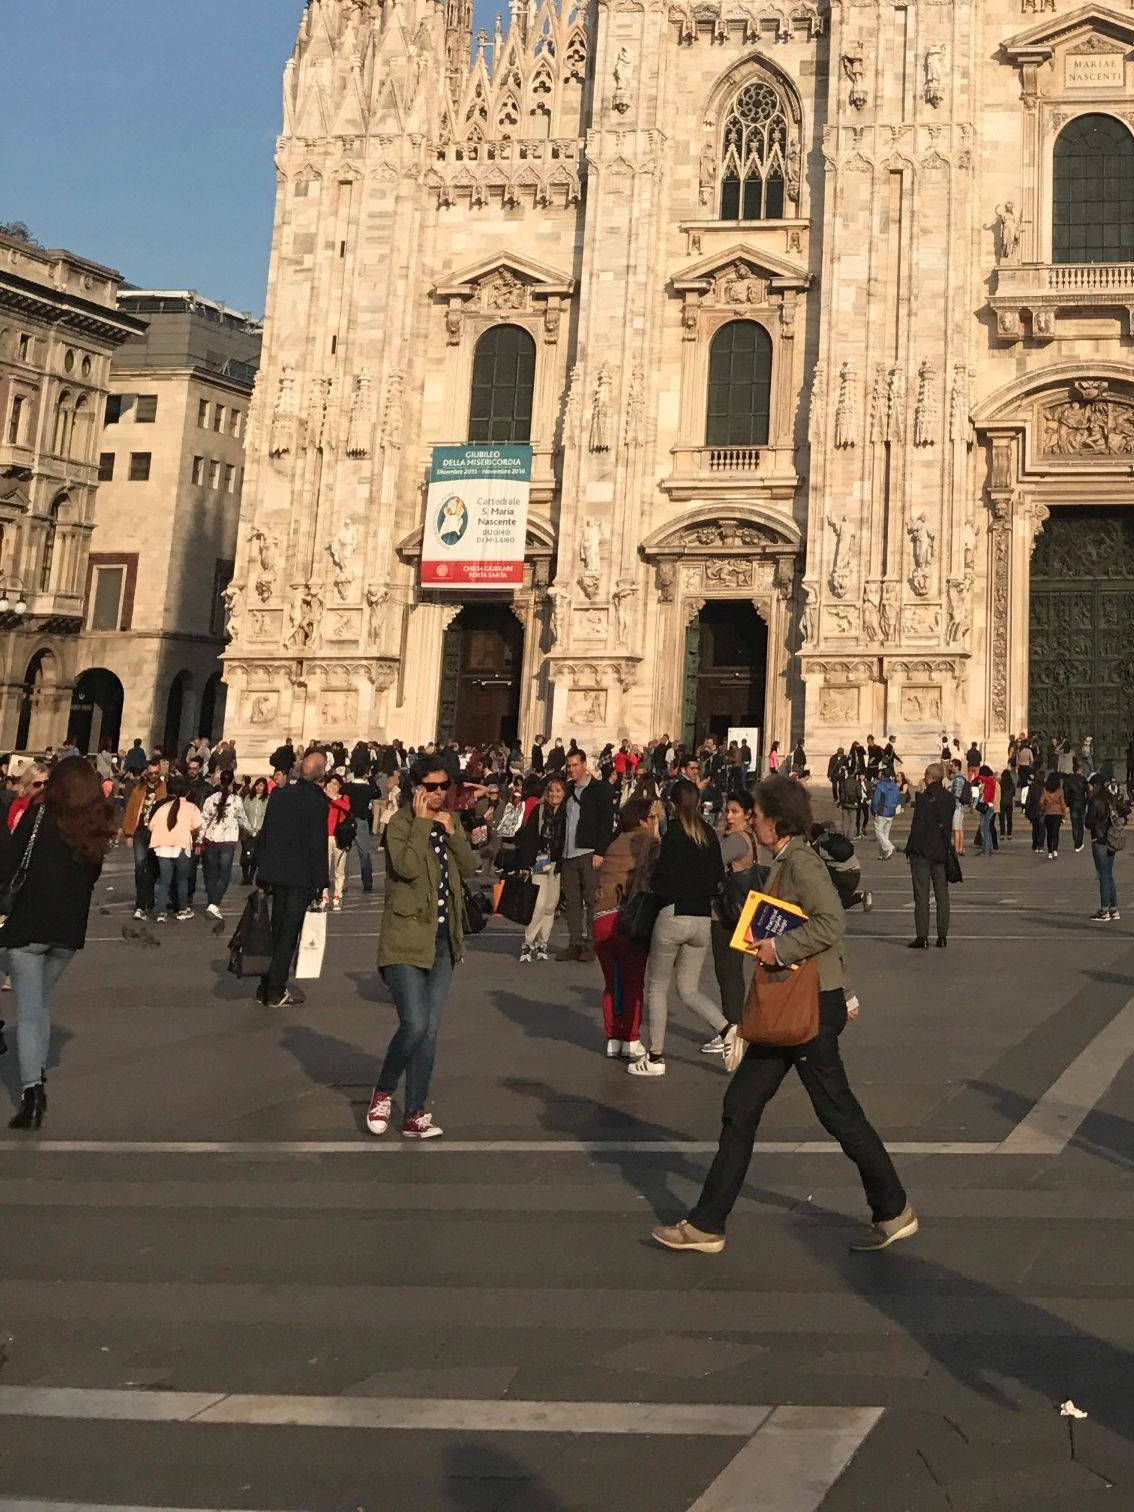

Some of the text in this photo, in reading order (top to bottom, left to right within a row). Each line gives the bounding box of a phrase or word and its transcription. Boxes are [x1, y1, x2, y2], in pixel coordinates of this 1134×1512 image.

[1074, 59, 1115, 68] MARIAE
[1069, 72, 1121, 80] NASCENTI
[467, 458, 521, 466] MISERICORDIA
[477, 497, 521, 505] Cattedrale
